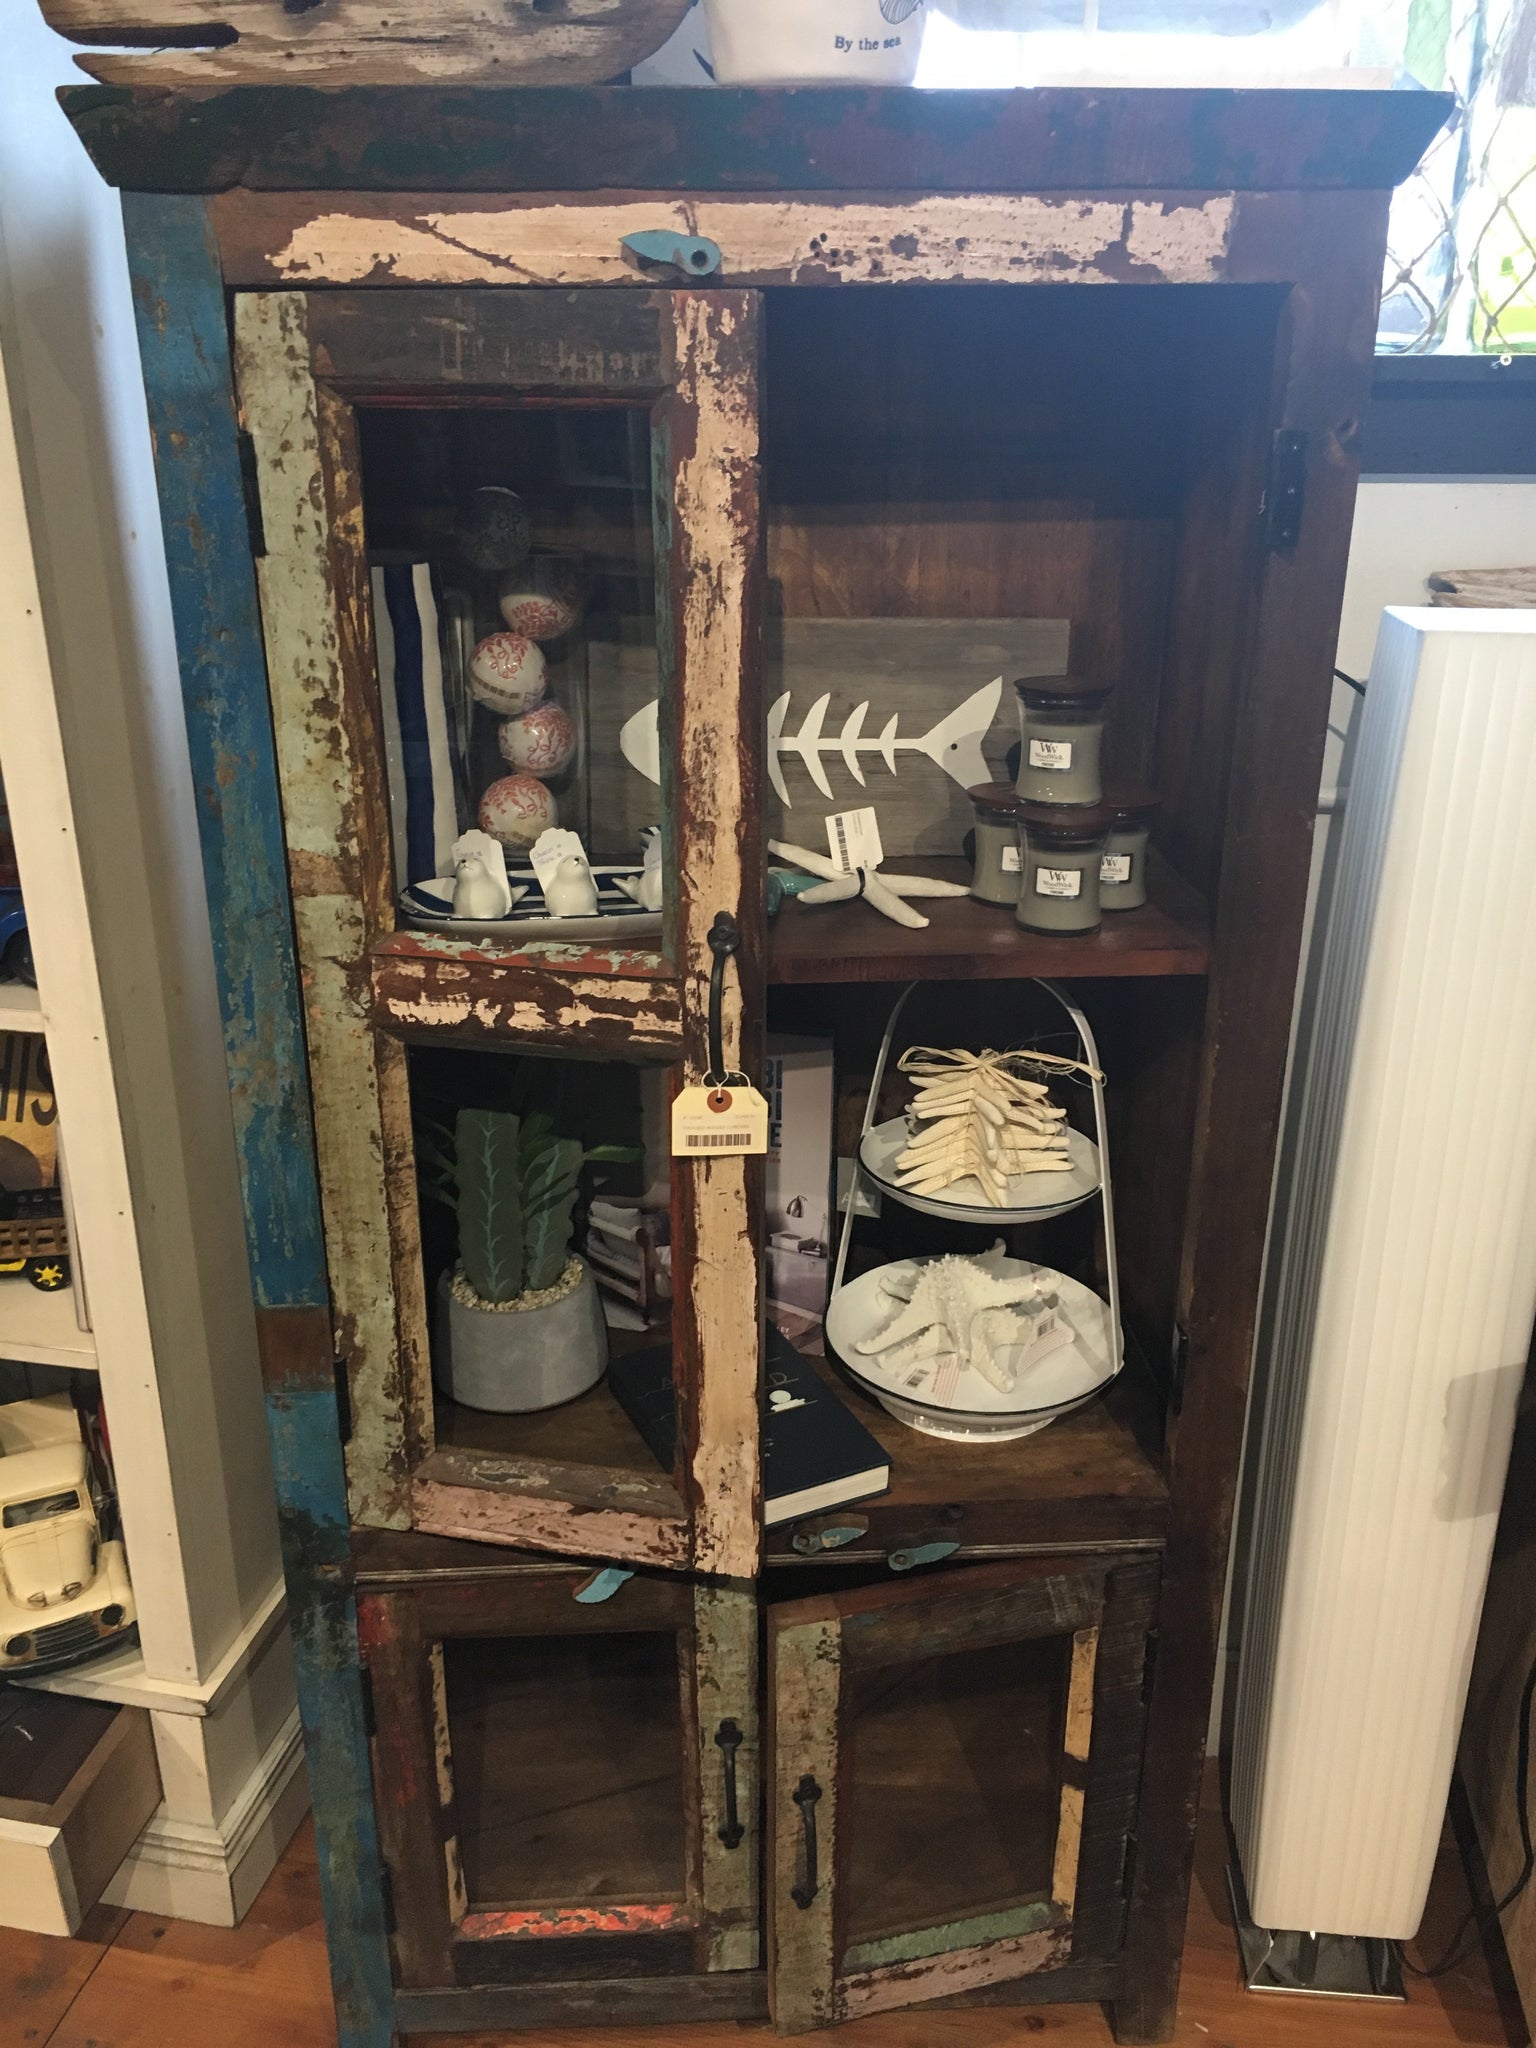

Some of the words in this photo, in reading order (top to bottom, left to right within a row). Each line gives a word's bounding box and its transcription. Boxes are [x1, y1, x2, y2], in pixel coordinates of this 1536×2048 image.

[835, 36, 853, 52] By
[859, 37, 880, 51] the
[883, 36, 902, 48] sea
